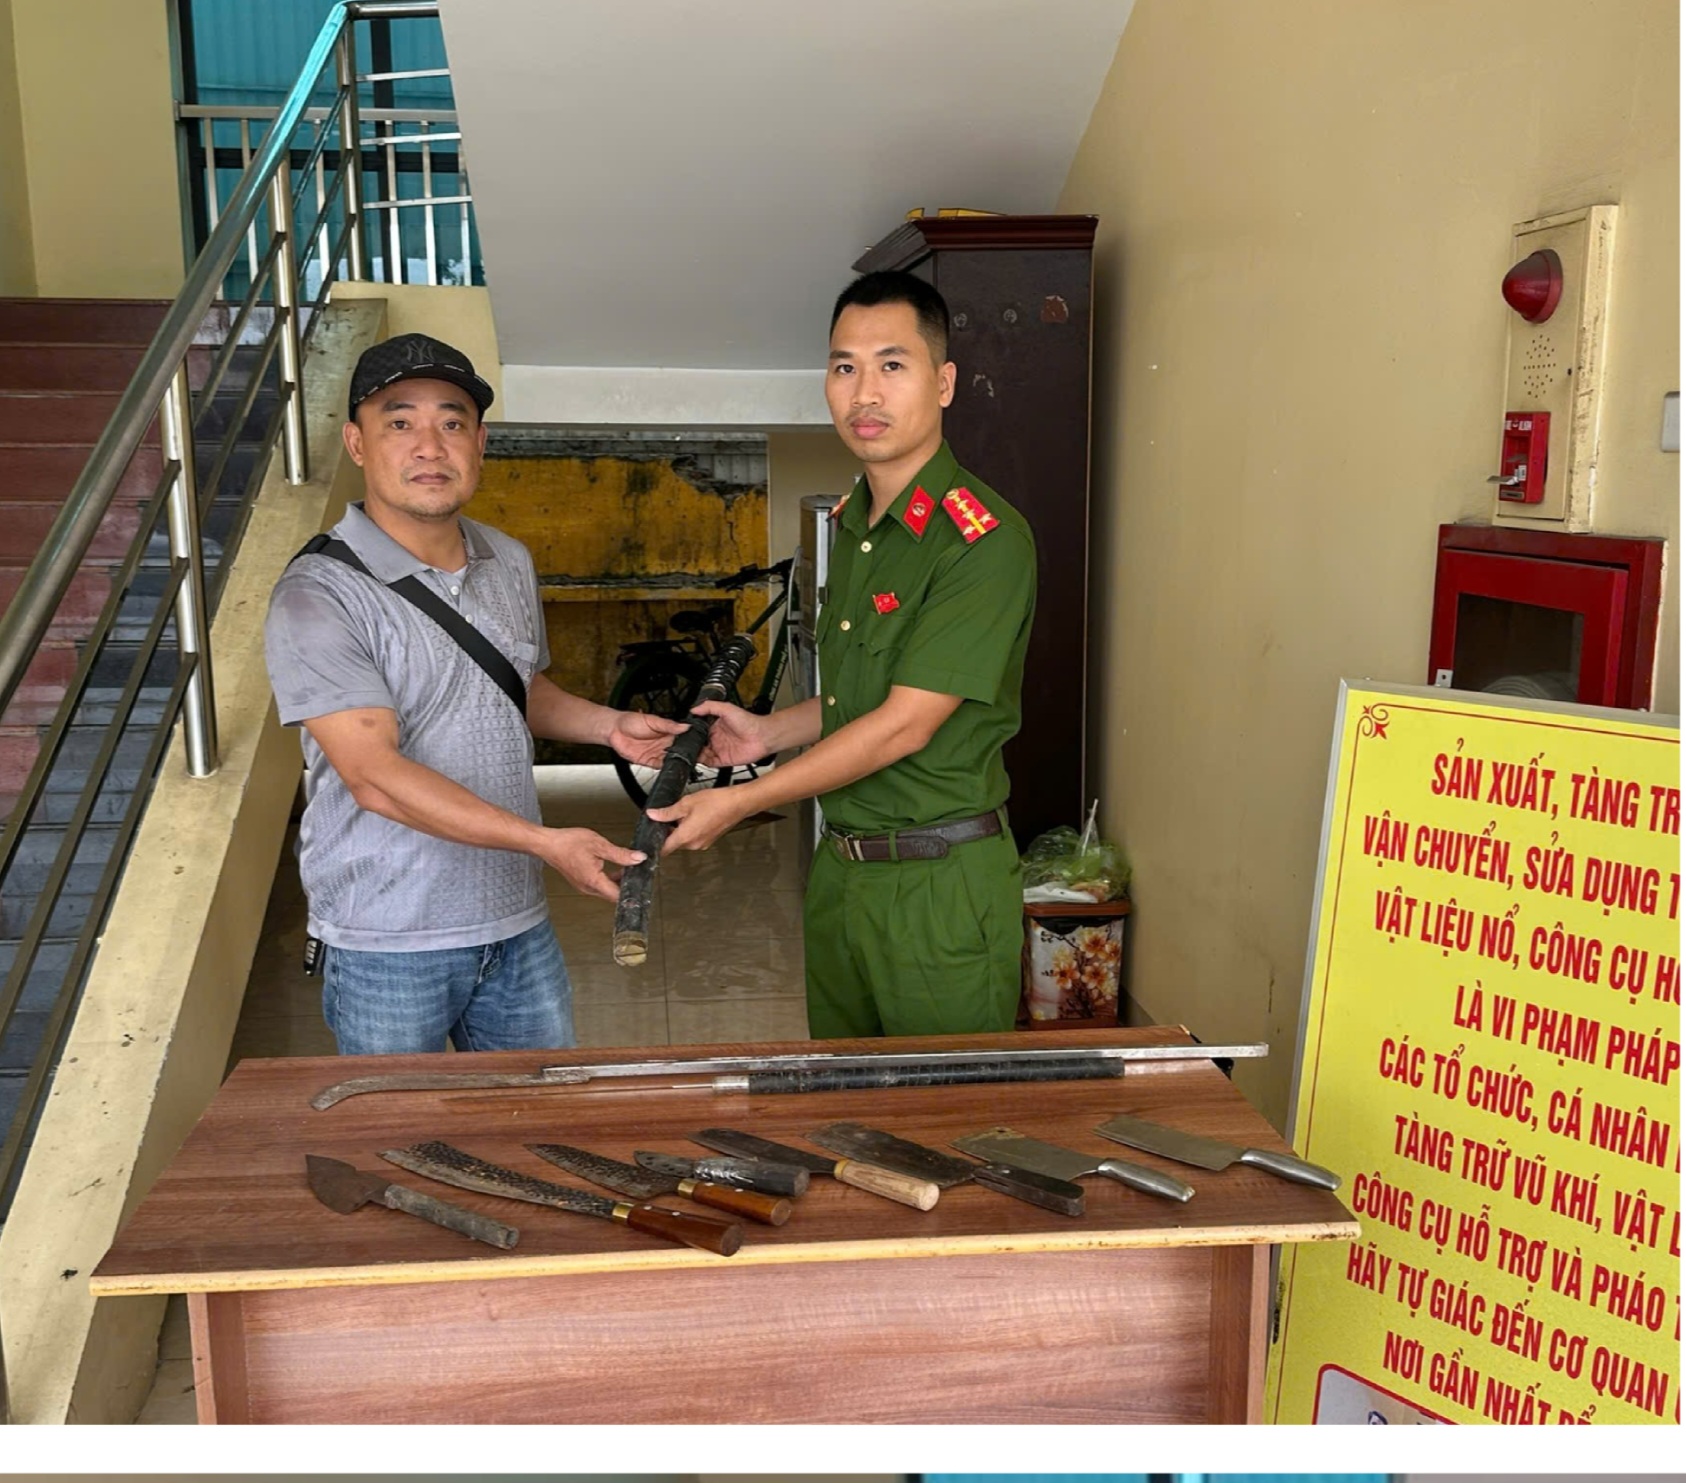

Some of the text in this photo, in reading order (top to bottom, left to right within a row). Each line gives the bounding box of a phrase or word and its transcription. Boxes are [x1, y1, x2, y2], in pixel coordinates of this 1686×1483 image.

[1431, 737, 1483, 801] SẢN
[1487, 752, 1558, 820] XUẤT,
[1570, 766, 1641, 828] TÀNG
[1364, 810, 1409, 867] VẬN
[1414, 821, 1514, 890] CHUYỂN,
[1523, 831, 1574, 898] SỬA
[1582, 857, 1660, 916] DỤNG
[1375, 886, 1417, 943] VẬT
[1420, 898, 1474, 957] LIỆU
[1478, 903, 1520, 970] NỔ,
[1529, 921, 1602, 984] CÔNG
[1609, 945, 1648, 1005] CỤ
[1454, 980, 1681, 1086] LÀ VI PHẠM PHÁP
[1379, 1035, 1425, 1088] CÁC
[1433, 1044, 1465, 1099] TỔ
[1466, 1064, 1538, 1132] CHỨC,
[1548, 1087, 1583, 1141] CÁ
[1589, 1102, 1670, 1168] NHÂN
[1394, 1111, 1454, 1173] TÀNG
[1461, 1138, 1512, 1191] TRỮ
[1514, 1154, 1547, 1205] VŨ
[1550, 1170, 1602, 1233] KHÍ,
[1613, 1189, 1666, 1252] VẬT
[1351, 1171, 1414, 1232] CÔNG
[1419, 1199, 1452, 1255] CỤ
[1456, 1204, 1491, 1262] HỖ
[1497, 1227, 1548, 1293] TRỢ
[1551, 1247, 1582, 1301] VÀ
[1589, 1264, 1666, 1332] PHÁO
[1347, 1241, 1392, 1295] HÃY
[1397, 1262, 1429, 1318] TỰ
[1429, 1278, 1486, 1336] GIÁC
[1490, 1299, 1544, 1362] ĐẾN
[1548, 1328, 1589, 1379] CƠ
[1591, 1346, 1669, 1417] QUAN
[1383, 1331, 1424, 1384] NƠI
[1429, 1347, 1479, 1410] GẦN
